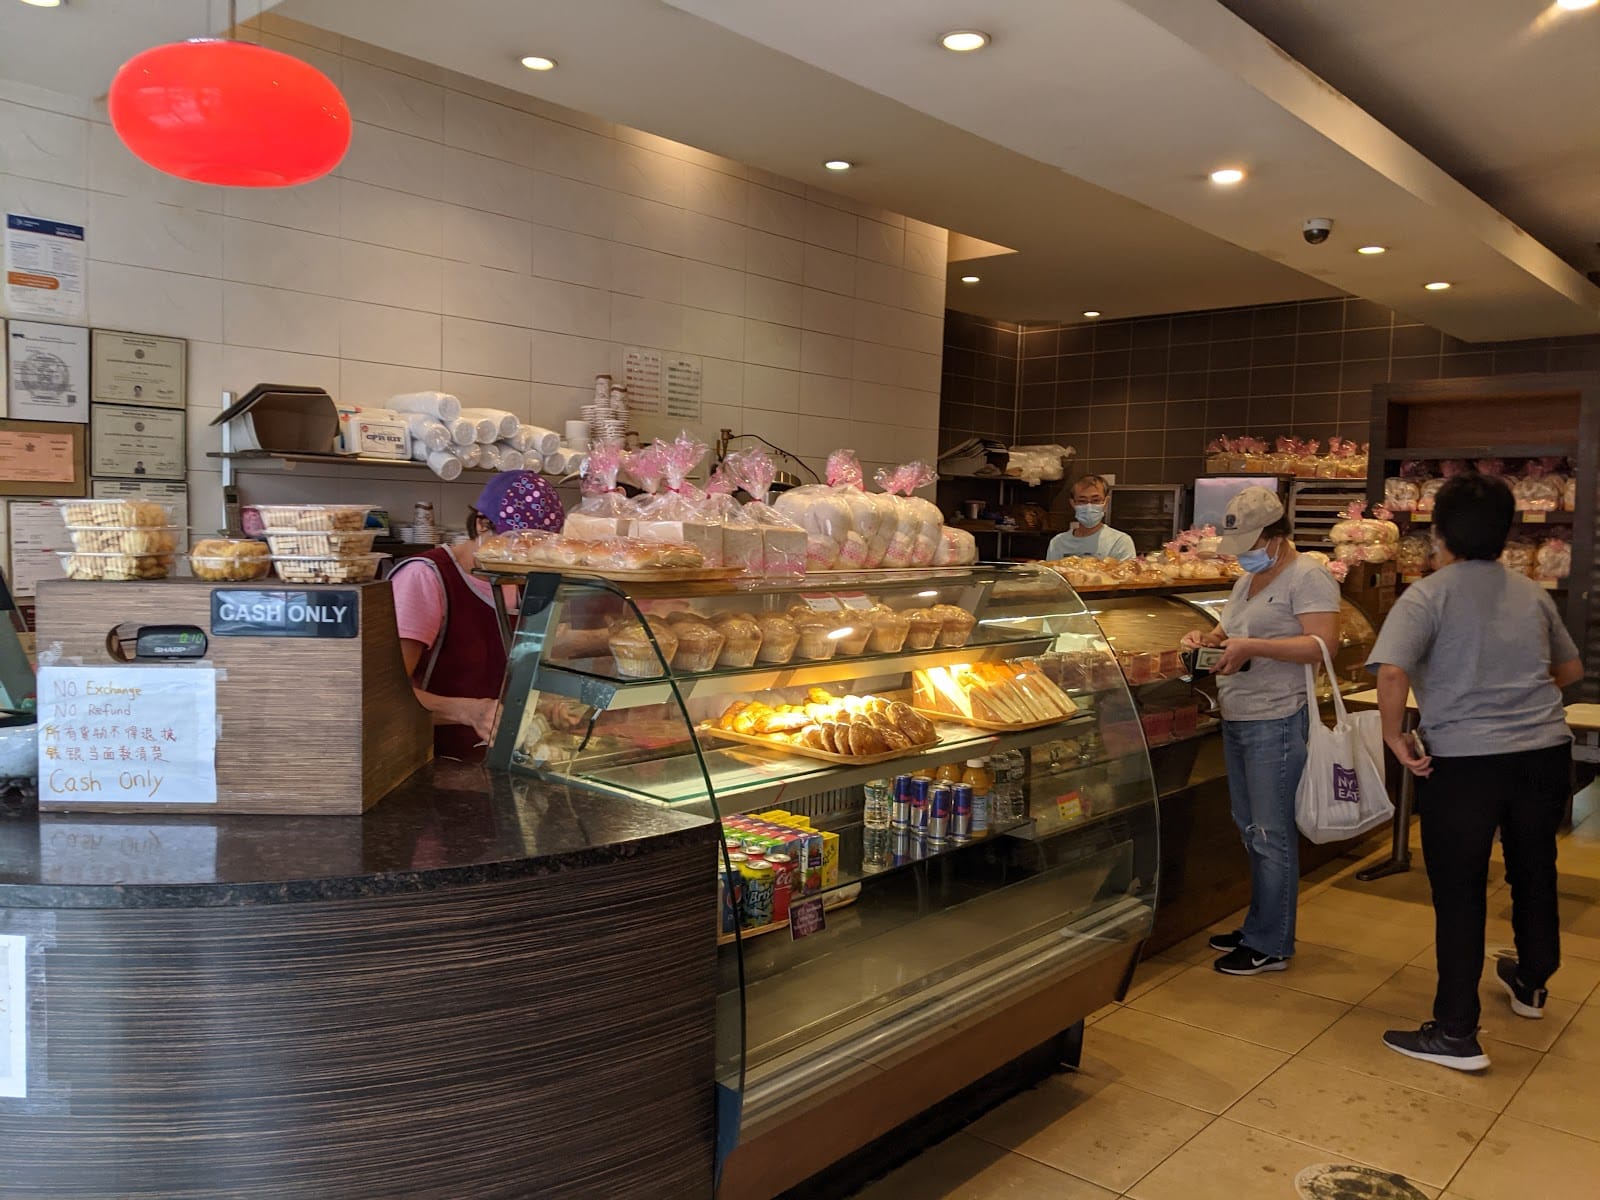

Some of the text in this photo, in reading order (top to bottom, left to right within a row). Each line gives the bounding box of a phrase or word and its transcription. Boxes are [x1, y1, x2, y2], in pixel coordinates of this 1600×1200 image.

[219, 603, 348, 624] CASH ONLY
[53, 680, 143, 701] NO Exchange
[54, 703, 132, 718] NO Refund
[49, 768, 164, 798] Cash Only
